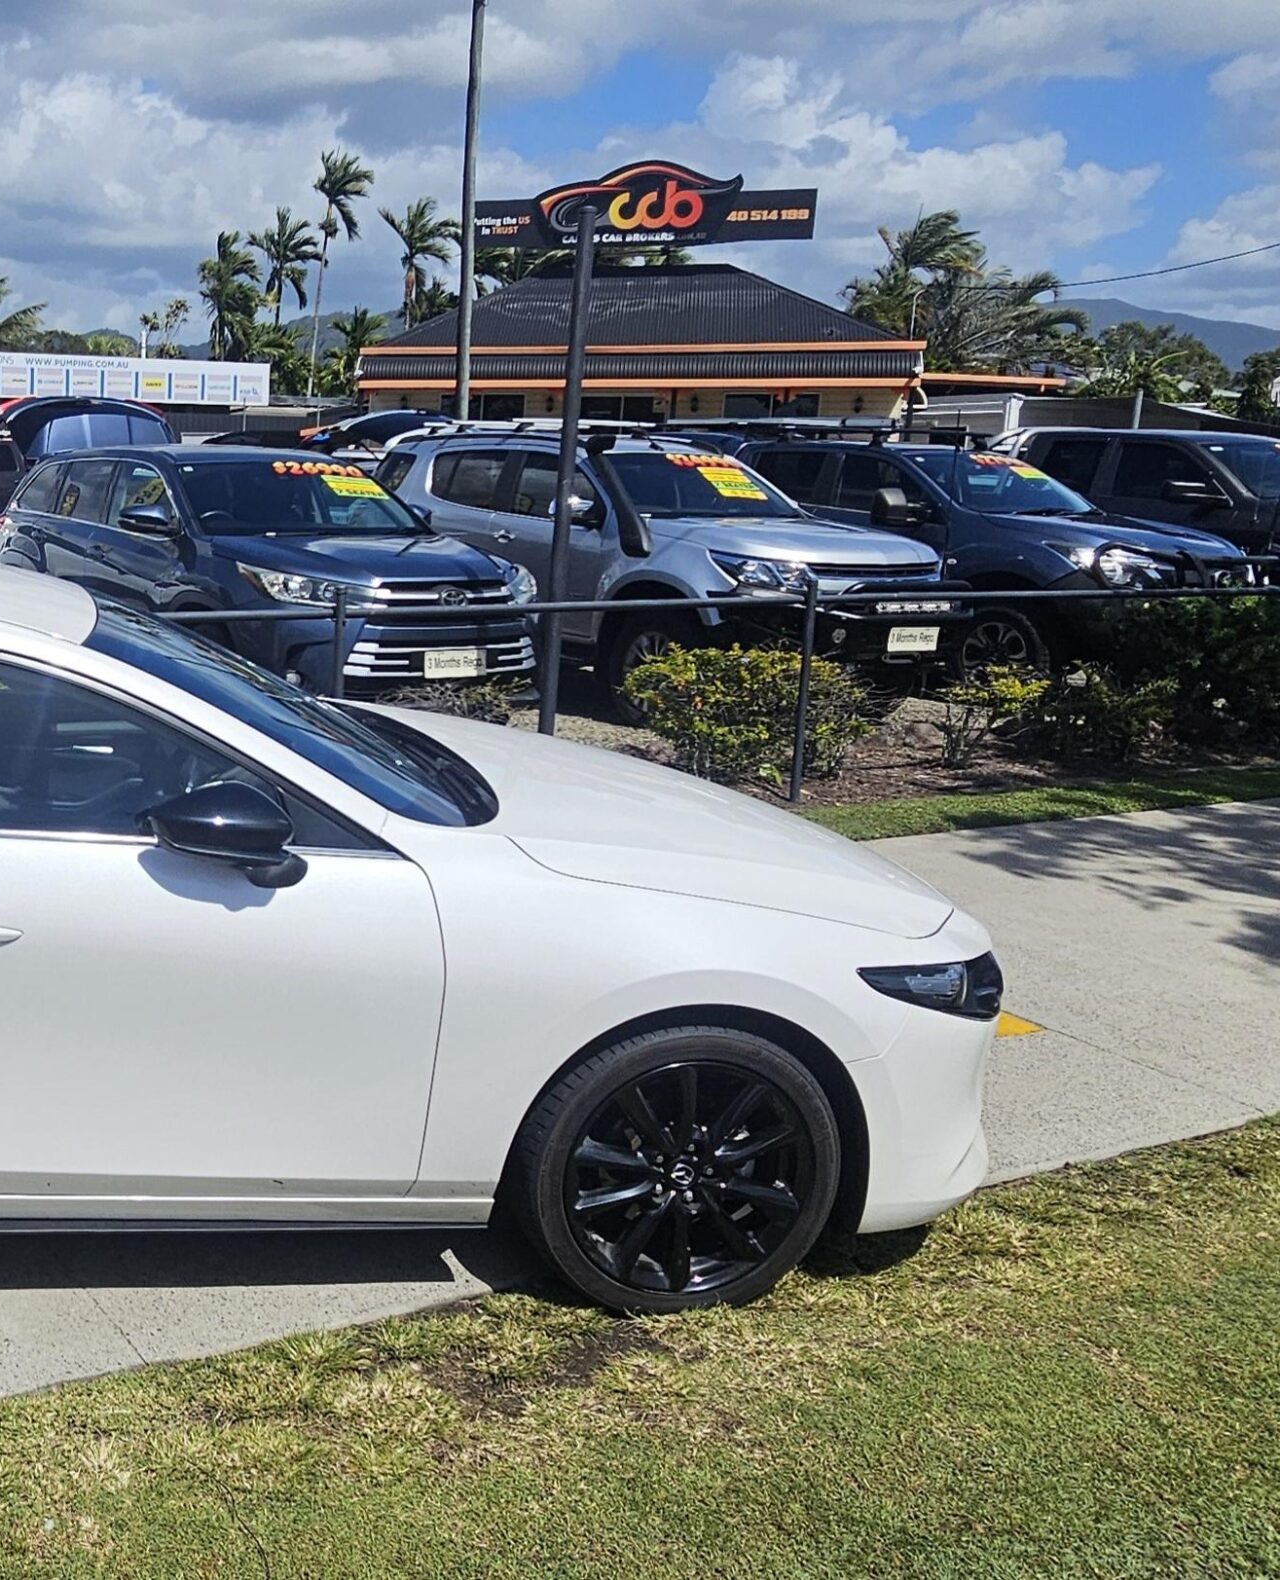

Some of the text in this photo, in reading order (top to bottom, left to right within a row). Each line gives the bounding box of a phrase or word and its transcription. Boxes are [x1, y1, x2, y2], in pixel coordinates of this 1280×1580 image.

[503, 216, 517, 225] the
[518, 216, 531, 225] US
[726, 210, 748, 222] 40
[750, 209, 778, 221] 514
[492, 226, 519, 235] TRUST
[601, 233, 623, 243] CAR
[25, 357, 129, 369] WWW.PUMPING.COM.AU
[272, 460, 364, 478] $26990
[427, 657, 433, 669] 3
[434, 657, 461, 669] Months
